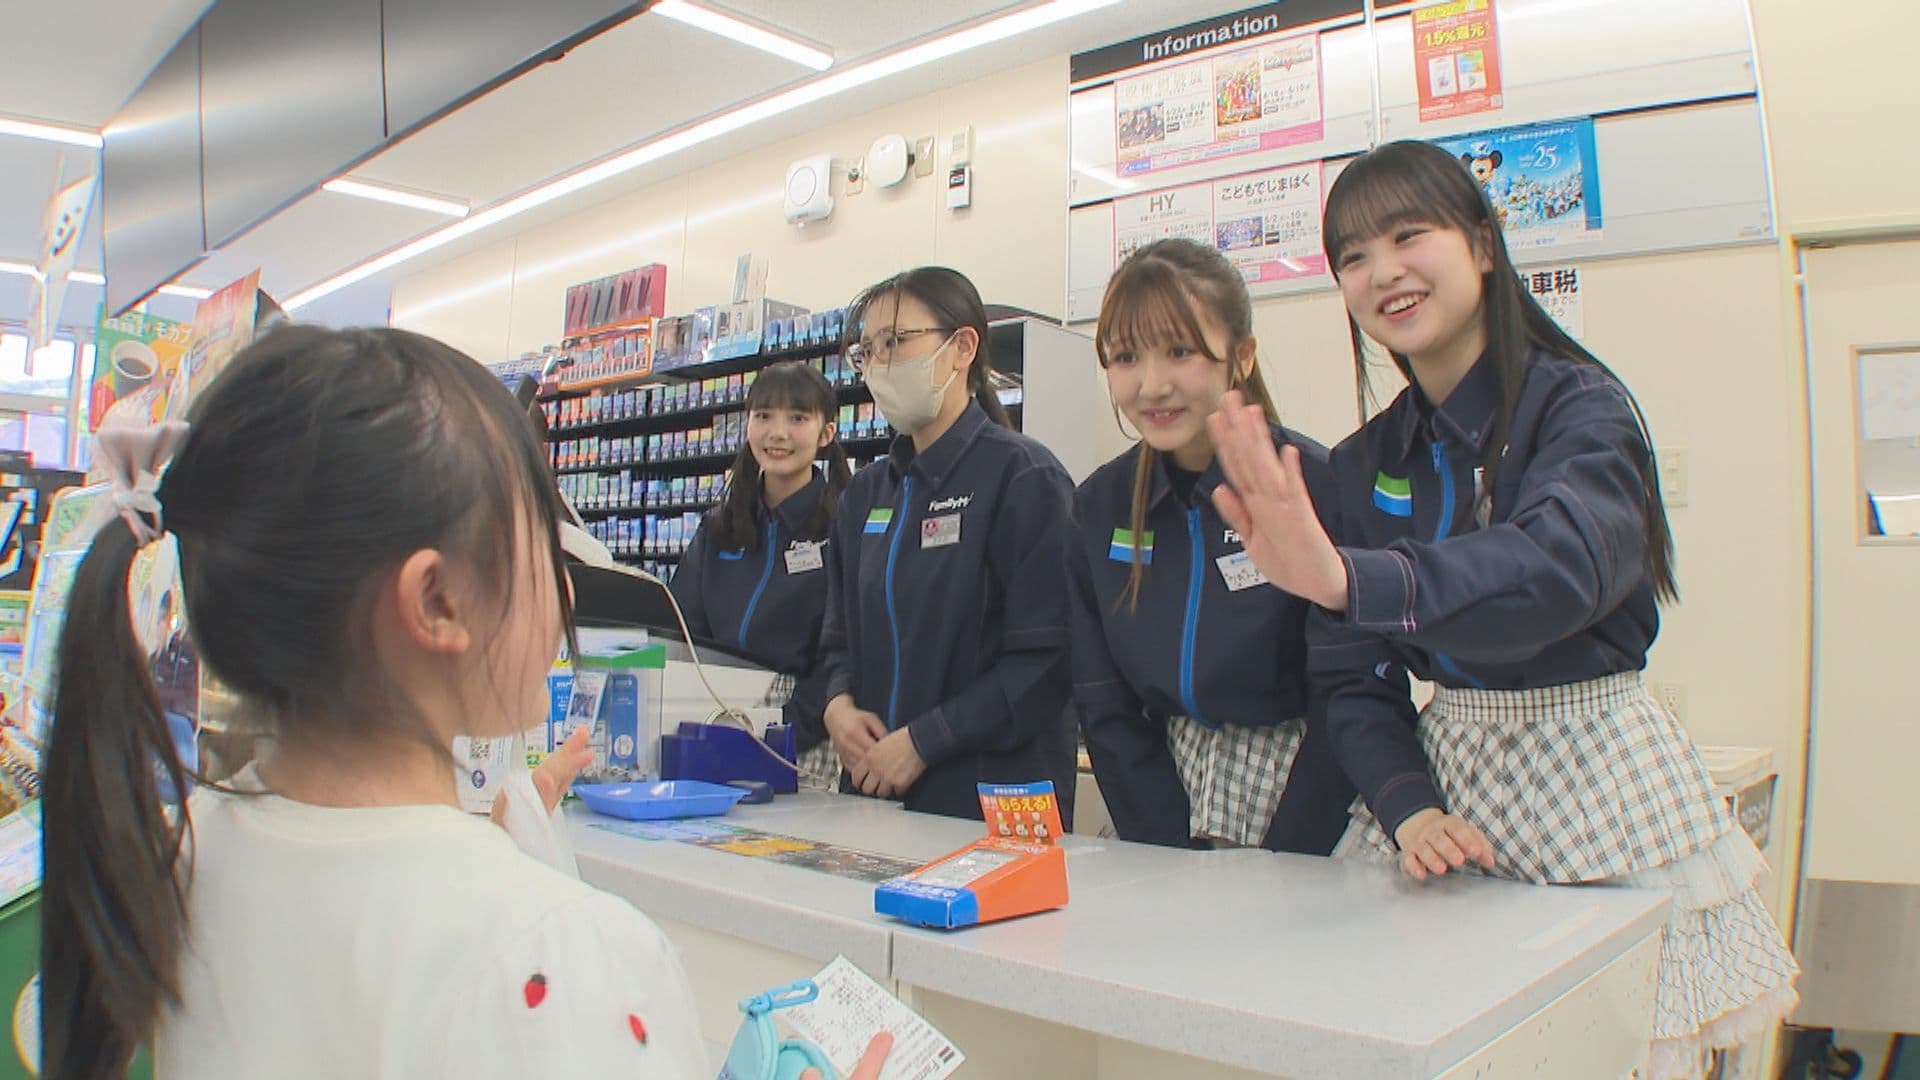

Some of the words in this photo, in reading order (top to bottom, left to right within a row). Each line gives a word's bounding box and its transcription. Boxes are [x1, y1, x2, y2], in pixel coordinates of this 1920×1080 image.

[1143, 13, 1279, 61] Information
[1534, 144, 1558, 170] 25
[1221, 172, 1311, 201] こどもでじまはく
[1149, 193, 1176, 213] HY
